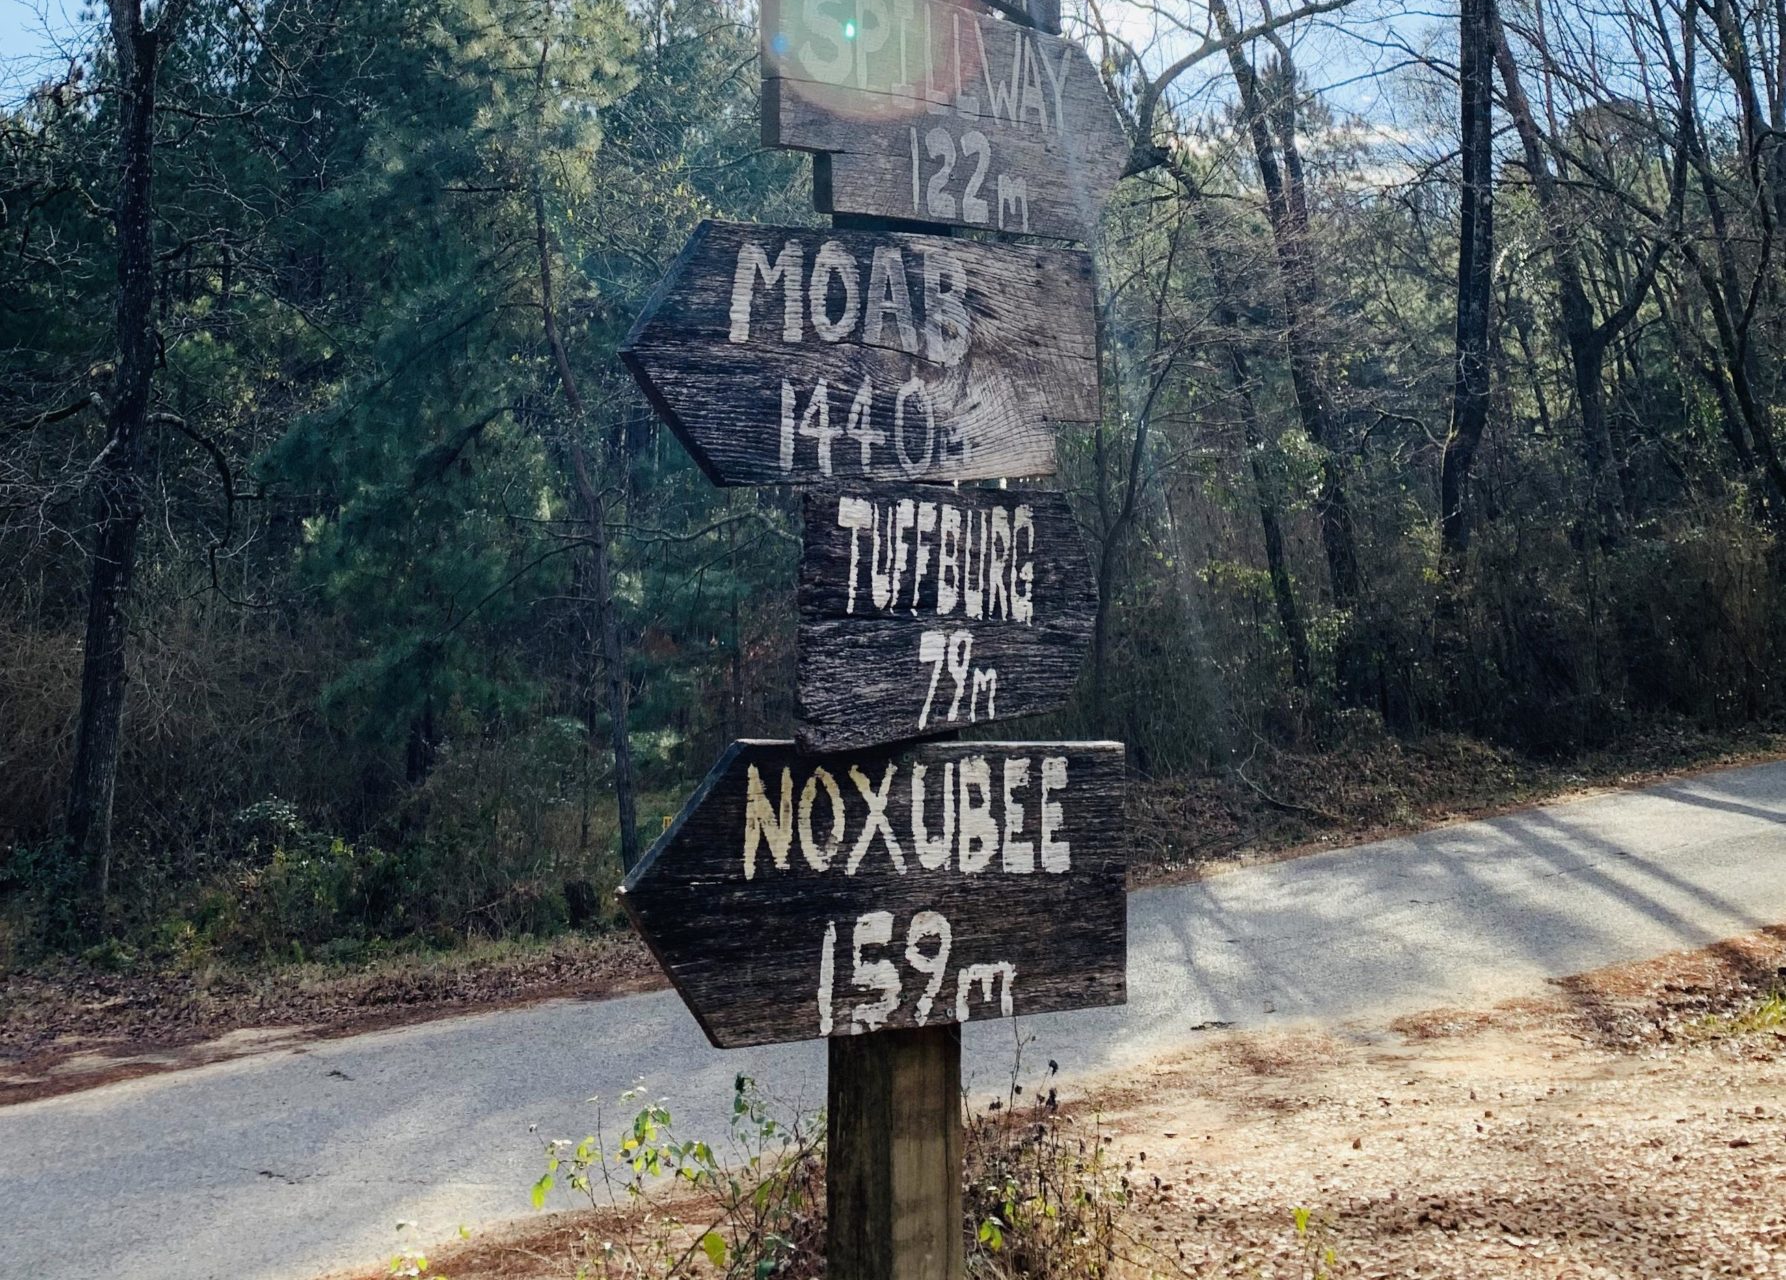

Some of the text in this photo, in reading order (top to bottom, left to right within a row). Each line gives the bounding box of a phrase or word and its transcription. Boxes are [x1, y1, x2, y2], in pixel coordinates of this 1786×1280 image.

[729, 239, 971, 368] MOAB
[838, 496, 1035, 626] TUFFBURG
[743, 755, 1071, 880] NOXUBEE
